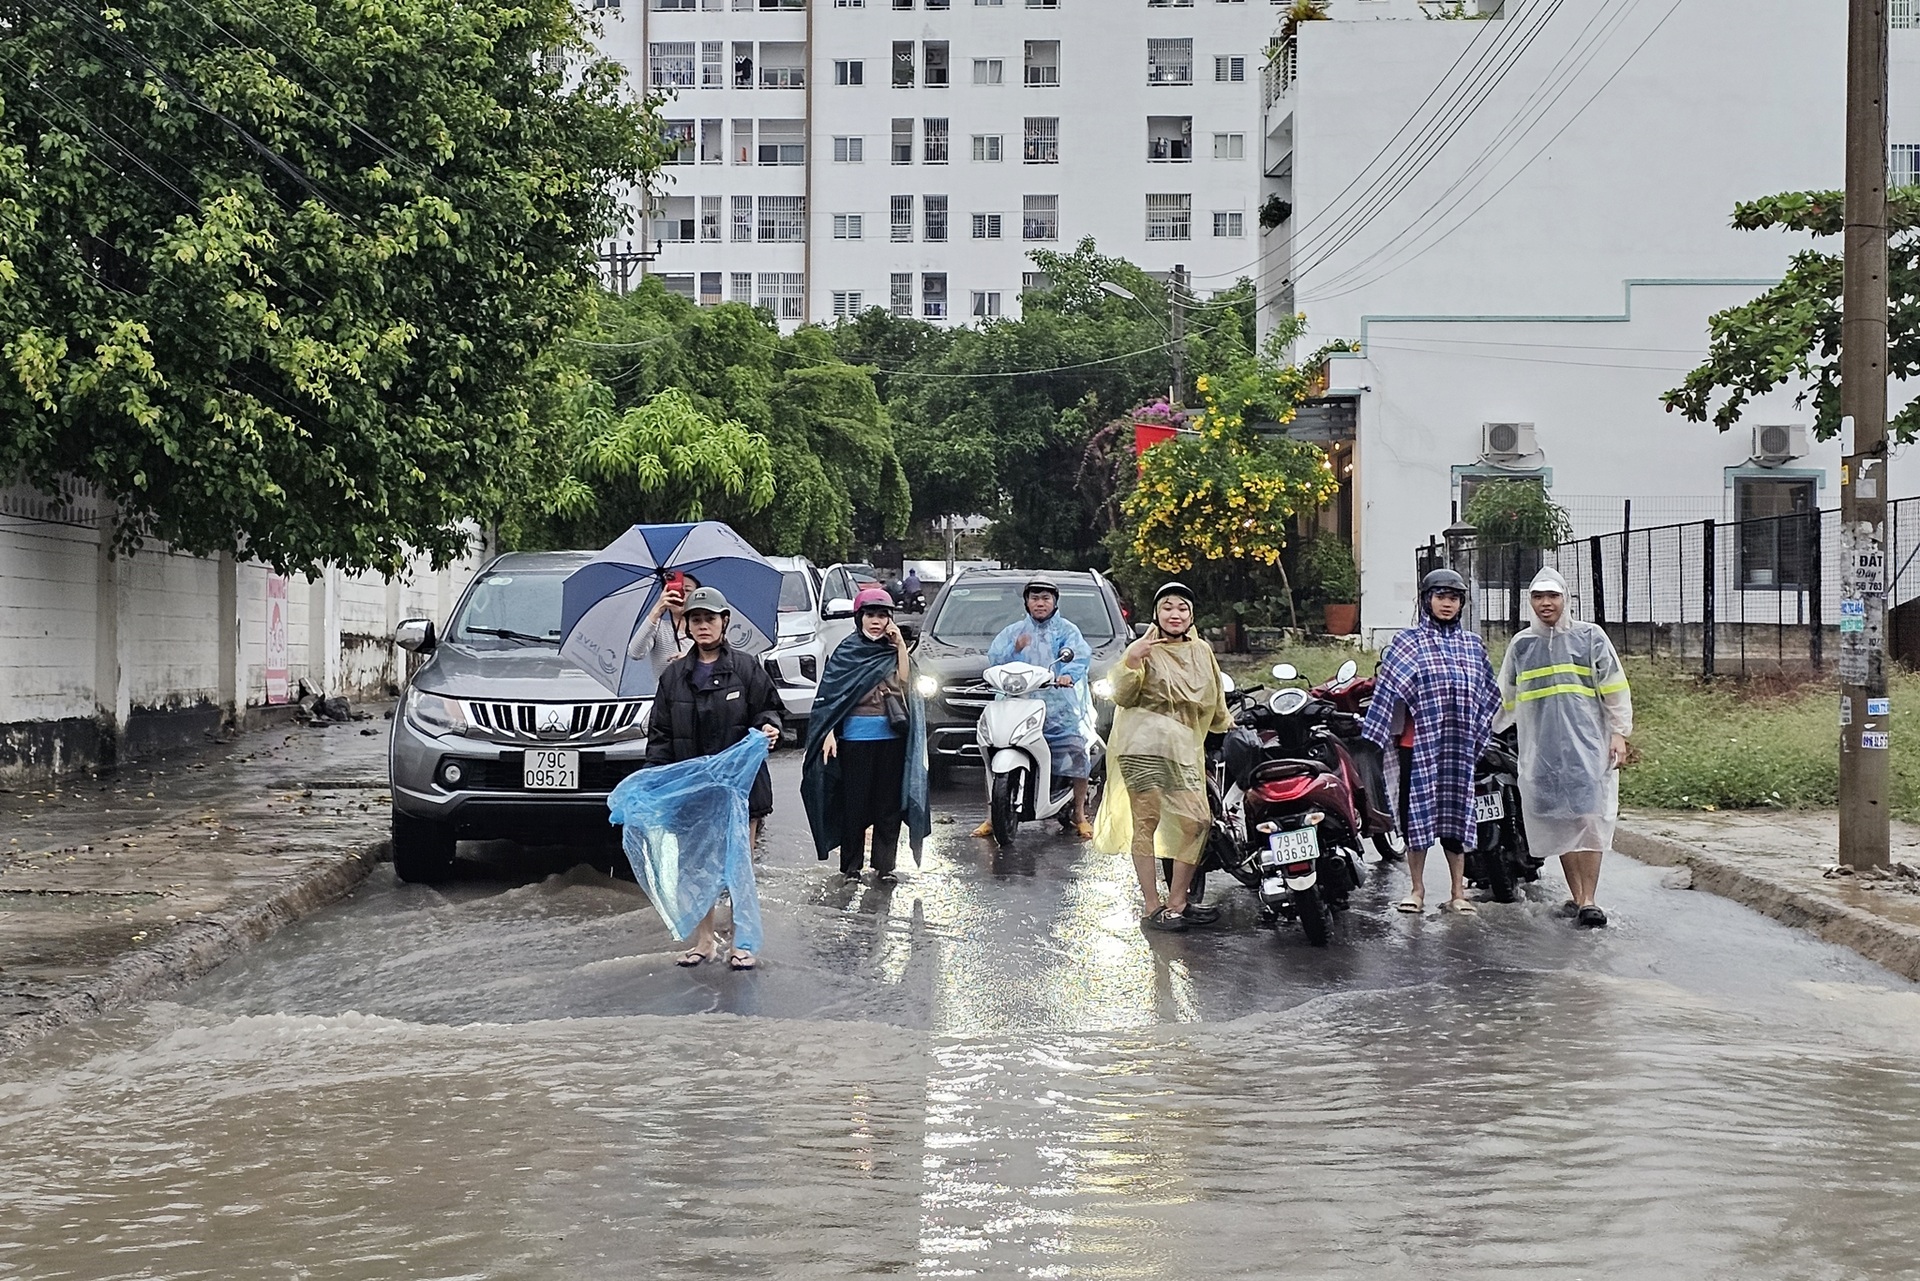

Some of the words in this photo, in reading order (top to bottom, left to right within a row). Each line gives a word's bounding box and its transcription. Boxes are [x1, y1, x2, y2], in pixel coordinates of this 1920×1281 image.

[1859, 552, 1883, 567] ĐẤT
[537, 751, 566, 769] 79C
[526, 769, 575, 787] 095.21
[1277, 831, 1309, 849] 79-DB
[1276, 844, 1315, 862] 036.92
